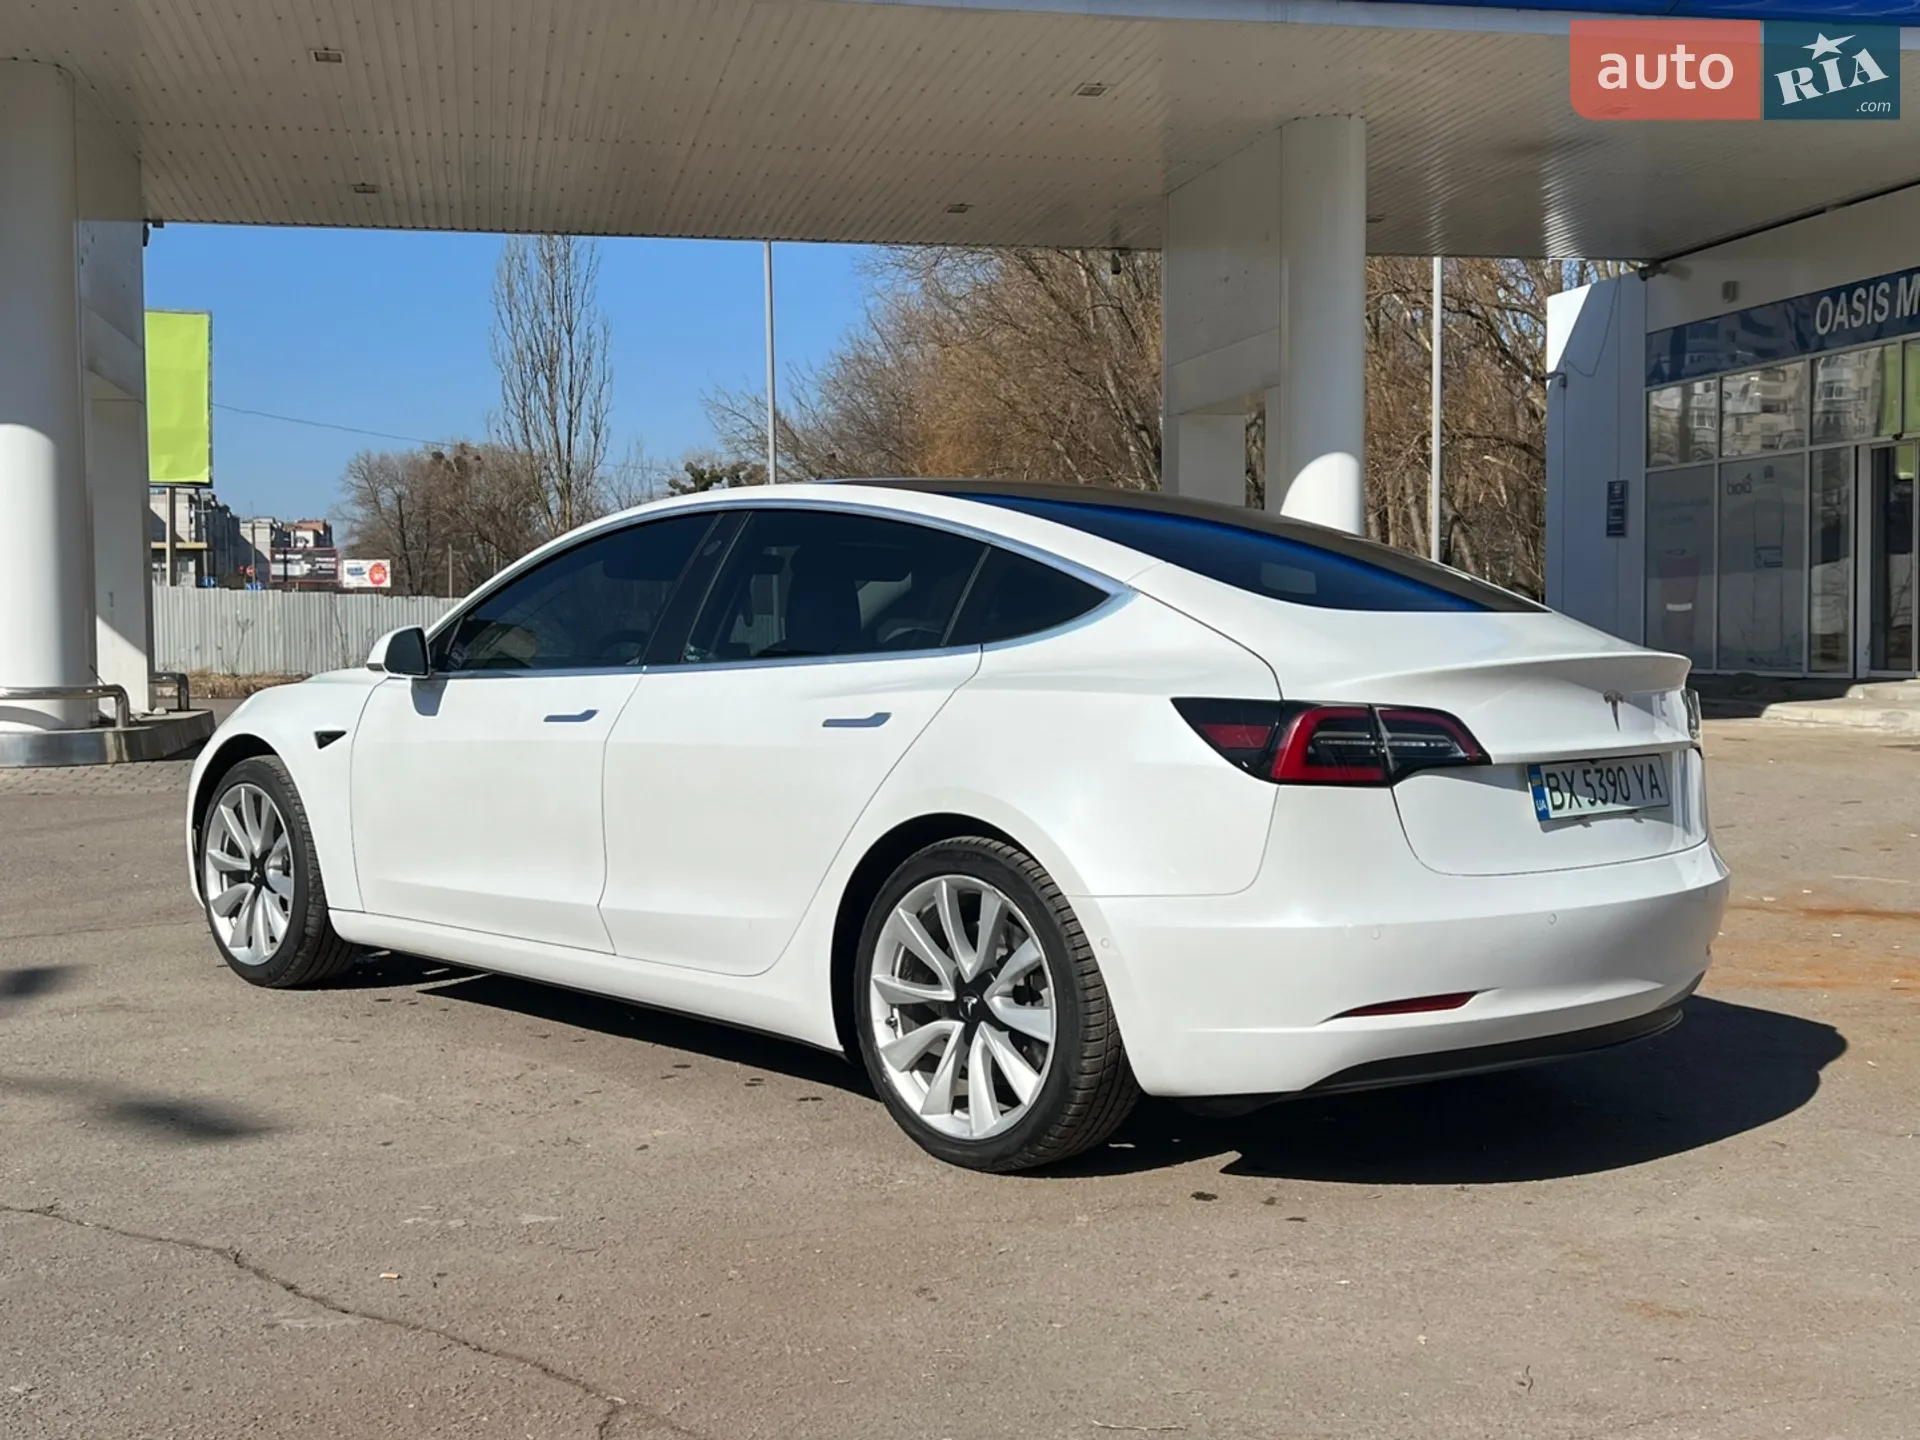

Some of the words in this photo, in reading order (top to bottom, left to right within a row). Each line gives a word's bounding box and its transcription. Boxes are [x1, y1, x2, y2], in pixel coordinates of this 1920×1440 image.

[1815, 282, 1891, 335] OASIS
[1545, 768, 1582, 811] BX
[1583, 766, 1631, 807] 5390
[1633, 763, 1663, 800] YA
